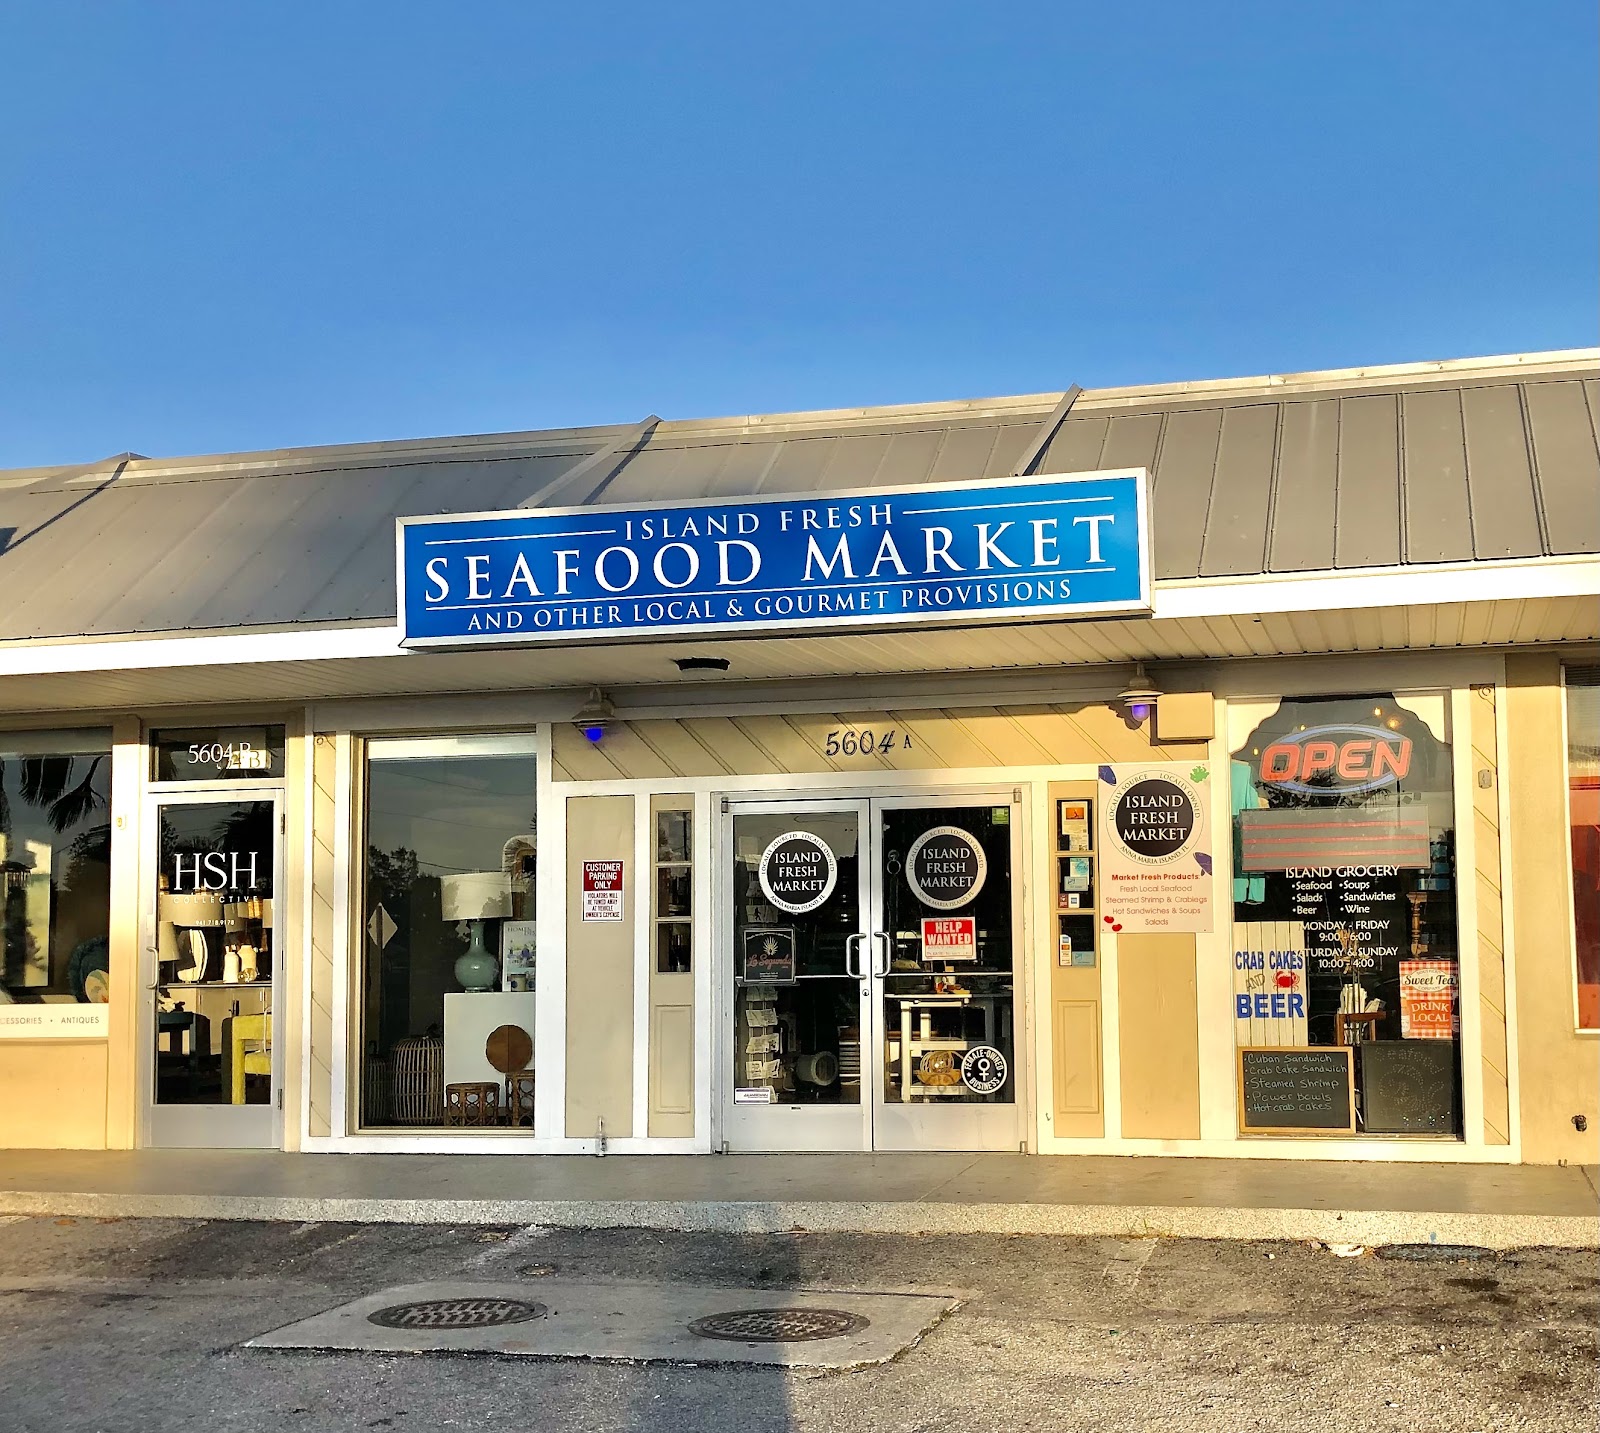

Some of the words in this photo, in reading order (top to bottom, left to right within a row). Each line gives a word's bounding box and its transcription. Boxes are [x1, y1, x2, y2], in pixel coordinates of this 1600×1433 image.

[625, 512, 760, 540] ISLAND
[780, 503, 893, 531] FRESH
[425, 540, 762, 603] SEAFOOD
[800, 514, 1115, 582] MARKET
[467, 610, 523, 630] AND
[534, 605, 622, 627] OTHER
[633, 600, 716, 621] LOCAL
[726, 598, 744, 616] &
[754, 590, 889, 616] GOURMET
[902, 578, 1071, 608] PROVISIONS
[826, 730, 896, 756] 5604
[903, 735, 912, 748] A
[187, 743, 233, 764] 5604
[1260, 738, 1412, 782] OPEN
[1109, 791, 1122, 820] LOCALLY
[1122, 774, 1147, 791] SOURCE
[1160, 773, 1188, 790] LOCALLY
[1187, 790, 1200, 818] OWNED
[1126, 795, 1184, 808] ISLAND
[1130, 812, 1178, 824] FRESH
[1123, 828, 1187, 840] MARKET
[761, 850, 772, 874] LOCALLY
[772, 834, 798, 848] SOURCED
[802, 834, 824, 848] LOCALLY
[824, 848, 834, 872] OWNED
[909, 845, 920, 870] LOCALLY
[920, 829, 946, 844] SOURCED
[923, 848, 970, 859] ISLAND
[950, 829, 974, 844] LOCALLY
[973, 844, 984, 868] OWNED
[775, 852, 821, 863] ISLAND
[1120, 846, 1137, 859] ANNA
[1138, 856, 1158, 864] MARIA
[174, 852, 258, 890] HSH
[586, 863, 621, 872] CUSTOMER
[779, 866, 816, 877] FRESH
[926, 862, 966, 873] FRESH
[1285, 867, 1332, 878] ISLAND
[1336, 865, 1400, 877] GROCERY
[589, 872, 617, 880] PARKING
[594, 881, 612, 889] ONLY
[773, 880, 825, 891] MARKET
[921, 877, 973, 888] MARKET
[1296, 881, 1332, 890] Seafood
[1343, 880, 1370, 891] Soups
[174, 896, 258, 904] COLLECTIVE
[771, 896, 783, 907] ANNA
[919, 892, 931, 903] ANNA
[1140, 896, 1164, 904] Shrimp
[1175, 896, 1207, 904] Crablegs
[1296, 893, 1323, 902] Salads
[1344, 892, 1396, 901] Sandwiches
[1297, 905, 1317, 914] Beer
[1345, 904, 1370, 913] Wine
[935, 921, 962, 933] HELP
[1299, 921, 1346, 930] MONDAY
[1355, 920, 1390, 930] FRIDAY
[927, 933, 971, 945] WANTED
[1319, 932, 1341, 941] 9:00
[1350, 932, 1371, 941] 6:00
[1347, 948, 1354, 957] &
[1358, 947, 1398, 957] SUNDAY
[1235, 951, 1264, 970] CRAB
[1269, 951, 1303, 970] CAKES
[1318, 959, 1344, 968] 10:00
[1353, 959, 1374, 968] 4:00
[1246, 974, 1265, 992] AND
[1404, 974, 1433, 985] Sweet
[1436, 974, 1454, 985] Tea
[1236, 993, 1305, 1018] BEER
[1411, 1002, 1449, 1012] DRINK
[61, 1016, 99, 1024] ANTIQUES
[1412, 1013, 1449, 1022] LOCAL
[964, 1050, 1004, 1070] FEMALE-OWNED
[1247, 1053, 1280, 1064] Cuban
[1283, 1054, 1332, 1063] Sandwich
[1249, 1066, 1273, 1075] Crab
[1275, 1065, 1299, 1074] Cake
[1302, 1064, 1347, 1073] Sandwich
[969, 1077, 1000, 1090] BUSINESS
[1250, 1077, 1295, 1089] Steamed
[1300, 1079, 1339, 1089] Shrimp
[1252, 1091, 1292, 1102] Power
[1297, 1092, 1332, 1102] Bowls
[1253, 1103, 1271, 1112] Hot
